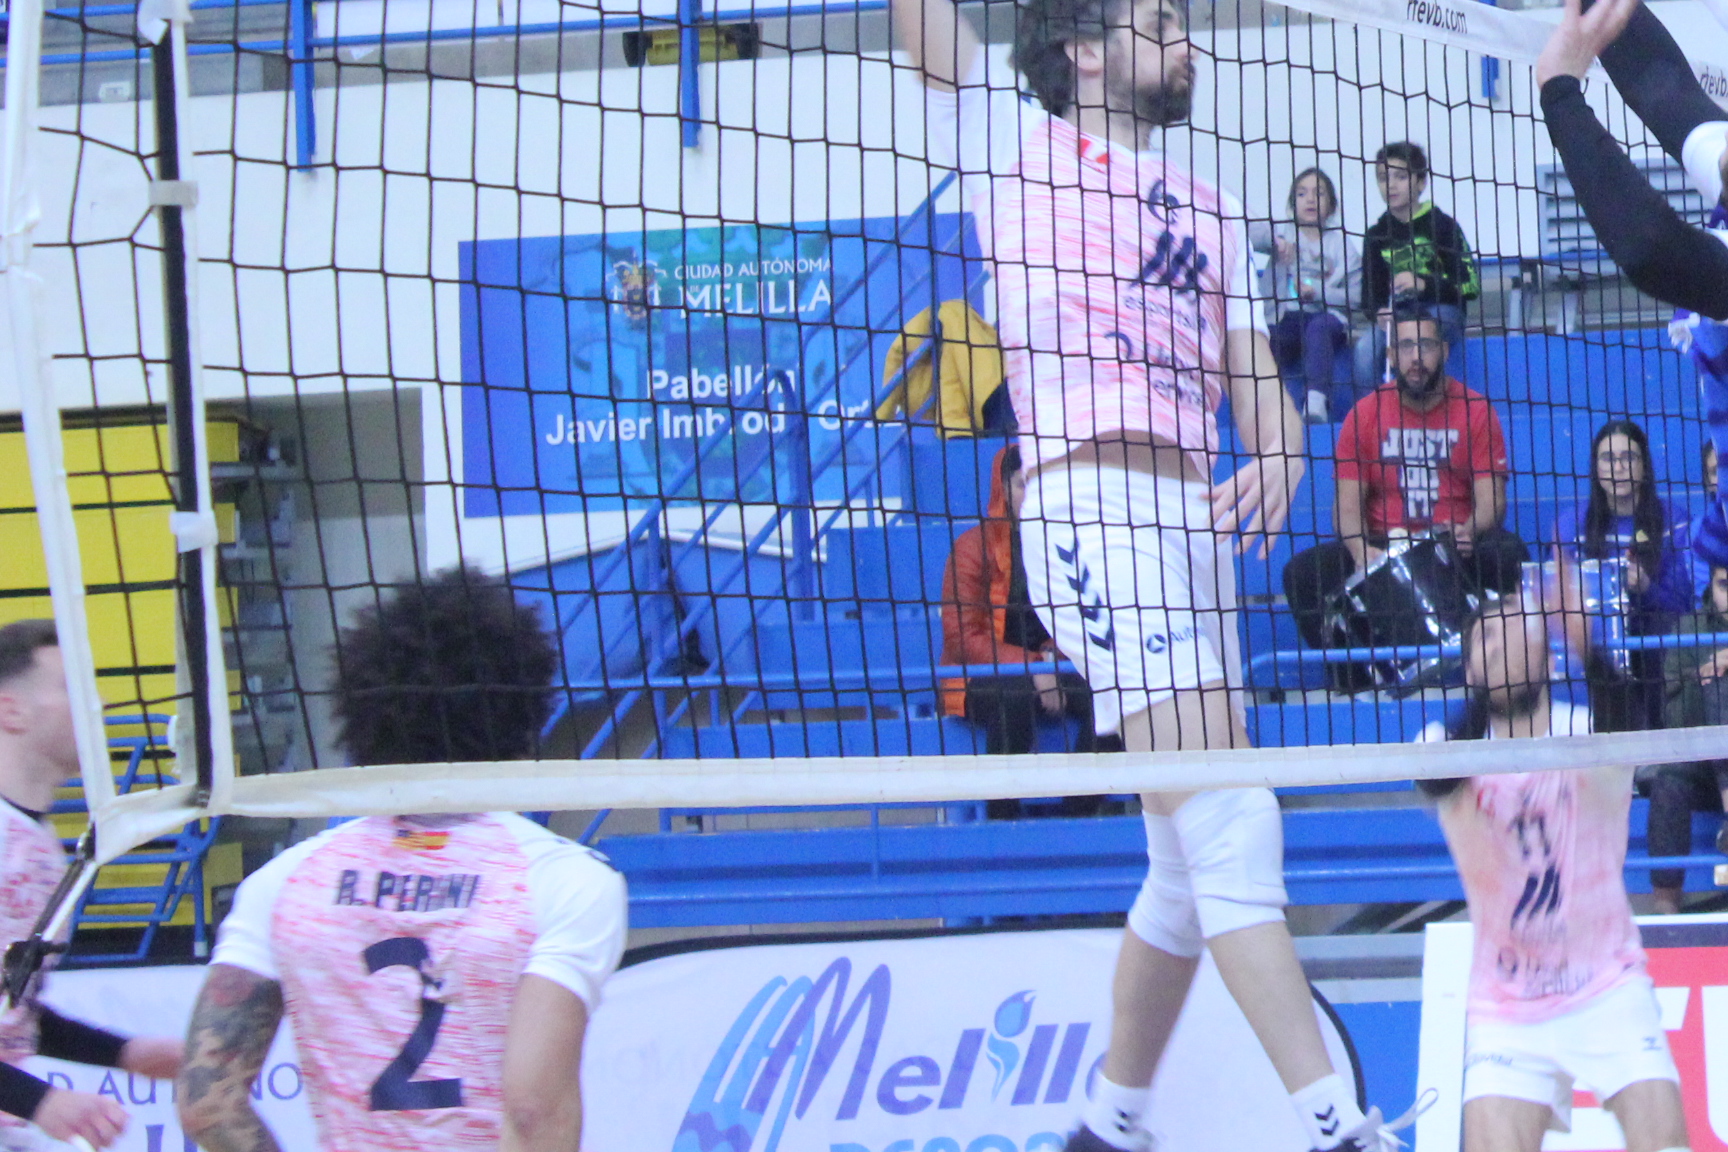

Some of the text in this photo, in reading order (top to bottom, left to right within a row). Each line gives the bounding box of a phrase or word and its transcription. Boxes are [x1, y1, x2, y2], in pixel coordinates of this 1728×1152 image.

[674, 263, 734, 280] CIUDAD
[678, 278, 832, 319] MELILLA
[545, 410, 653, 446] Javier
[1381, 427, 1459, 459] JUST
[362, 935, 464, 1112] 2
